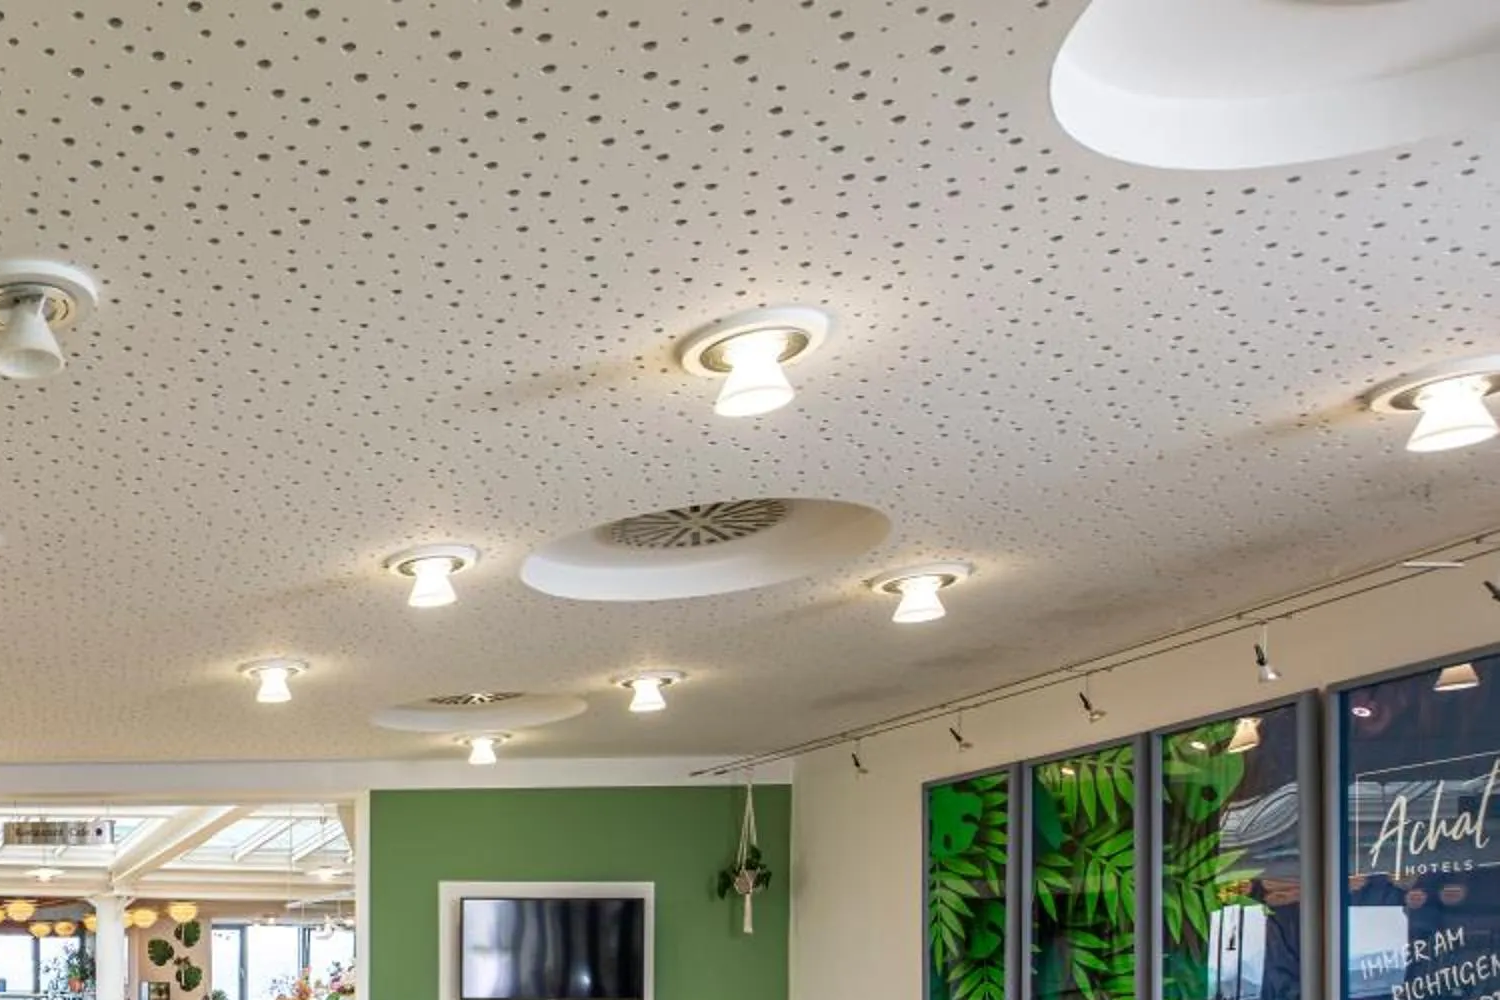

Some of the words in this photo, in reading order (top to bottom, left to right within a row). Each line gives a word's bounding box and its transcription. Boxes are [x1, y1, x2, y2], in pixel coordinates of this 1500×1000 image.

[1405, 859, 1474, 876] HOTELS
[1361, 939, 1430, 980] IMMER
[1434, 926, 1465, 957] AM
